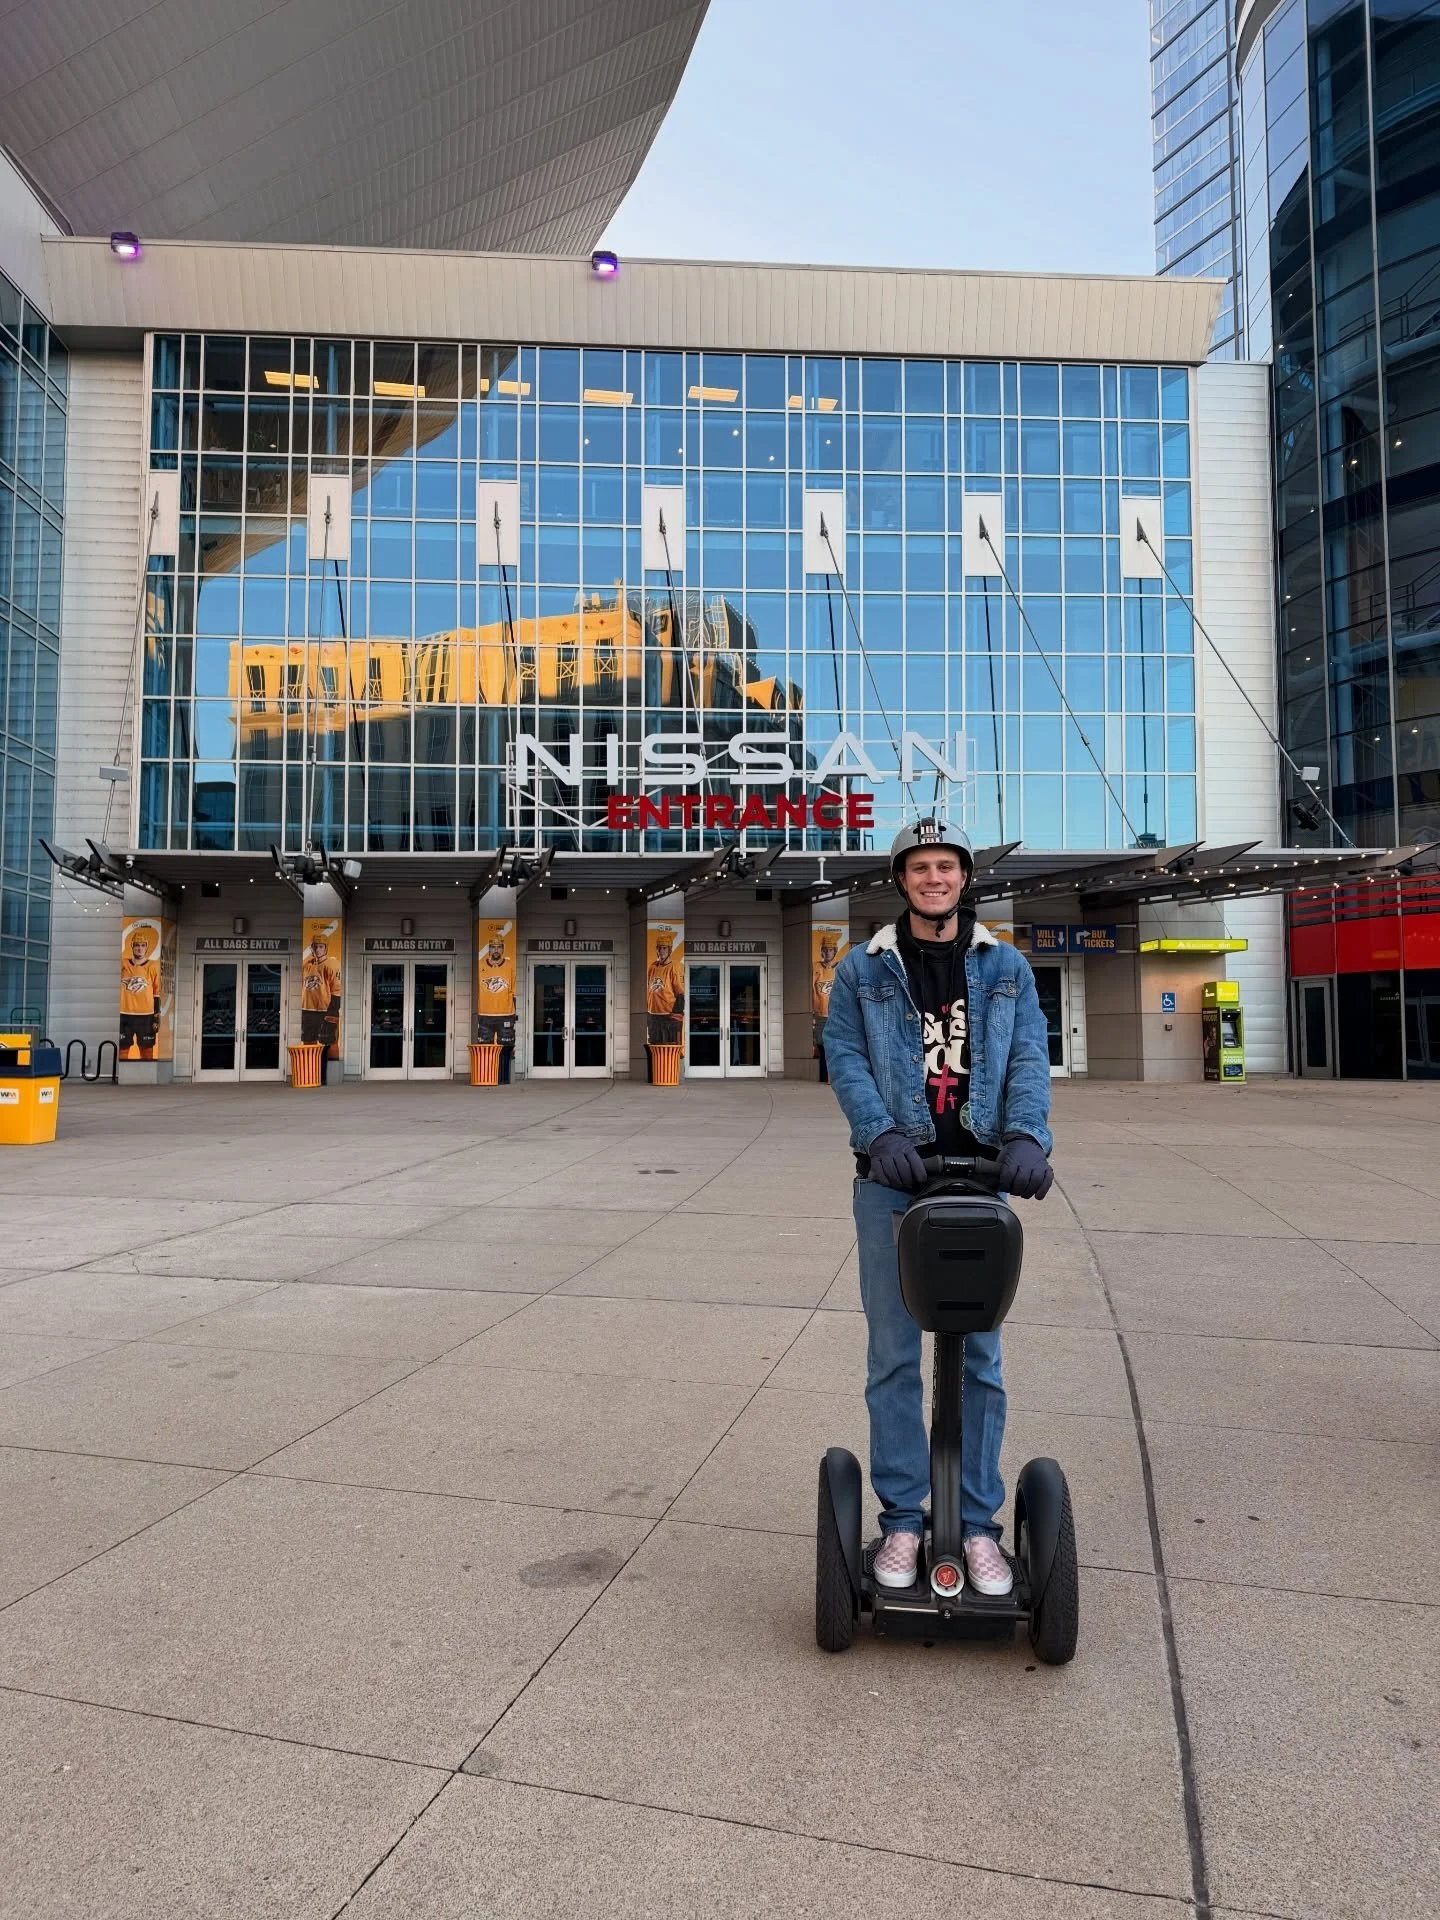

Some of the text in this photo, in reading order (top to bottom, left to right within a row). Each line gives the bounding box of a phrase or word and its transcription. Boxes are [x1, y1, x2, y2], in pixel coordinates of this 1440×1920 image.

[516, 731, 967, 786] NISSAN
[608, 794, 875, 830] ENTRANCE
[1037, 929, 1056, 939] WILL
[1091, 930, 1107, 938] BUY
[204, 939, 281, 949] ALL BAGS ENTRY
[373, 940, 447, 949] ALL BAGS ENTRY
[538, 941, 602, 951] NO BAG ENTRY
[693, 942, 756, 952] NO BAG ENTRY
[1037, 939, 1056, 948] CALL
[1084, 939, 1115, 948] TICKETS
